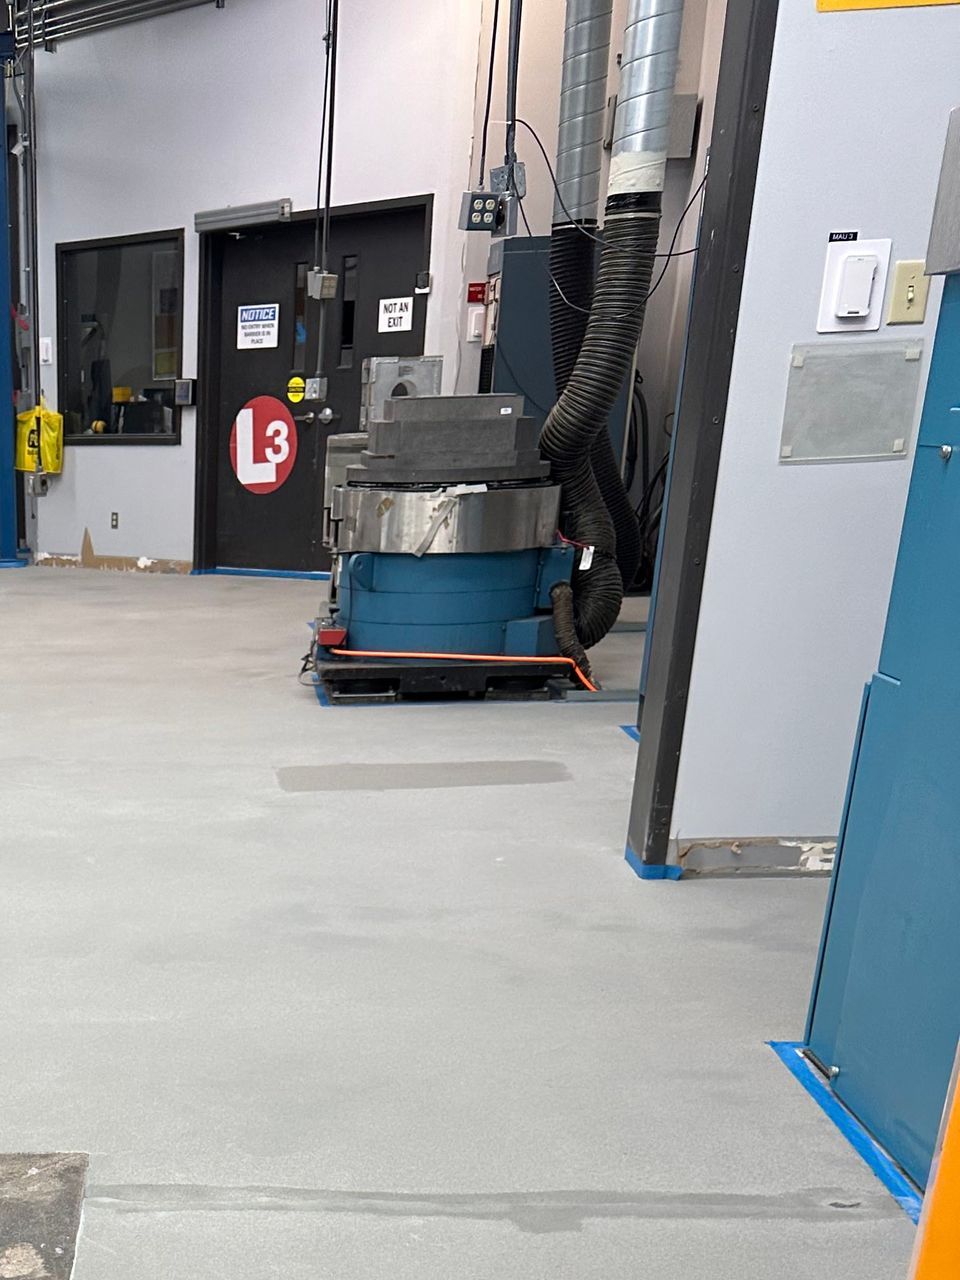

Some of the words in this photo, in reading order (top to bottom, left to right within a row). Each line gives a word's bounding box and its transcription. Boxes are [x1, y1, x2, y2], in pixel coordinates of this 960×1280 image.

[383, 303, 397, 314] NOT
[398, 302, 409, 313] AN
[241, 308, 276, 321] NOTICE
[387, 316, 403, 328] EXIT
